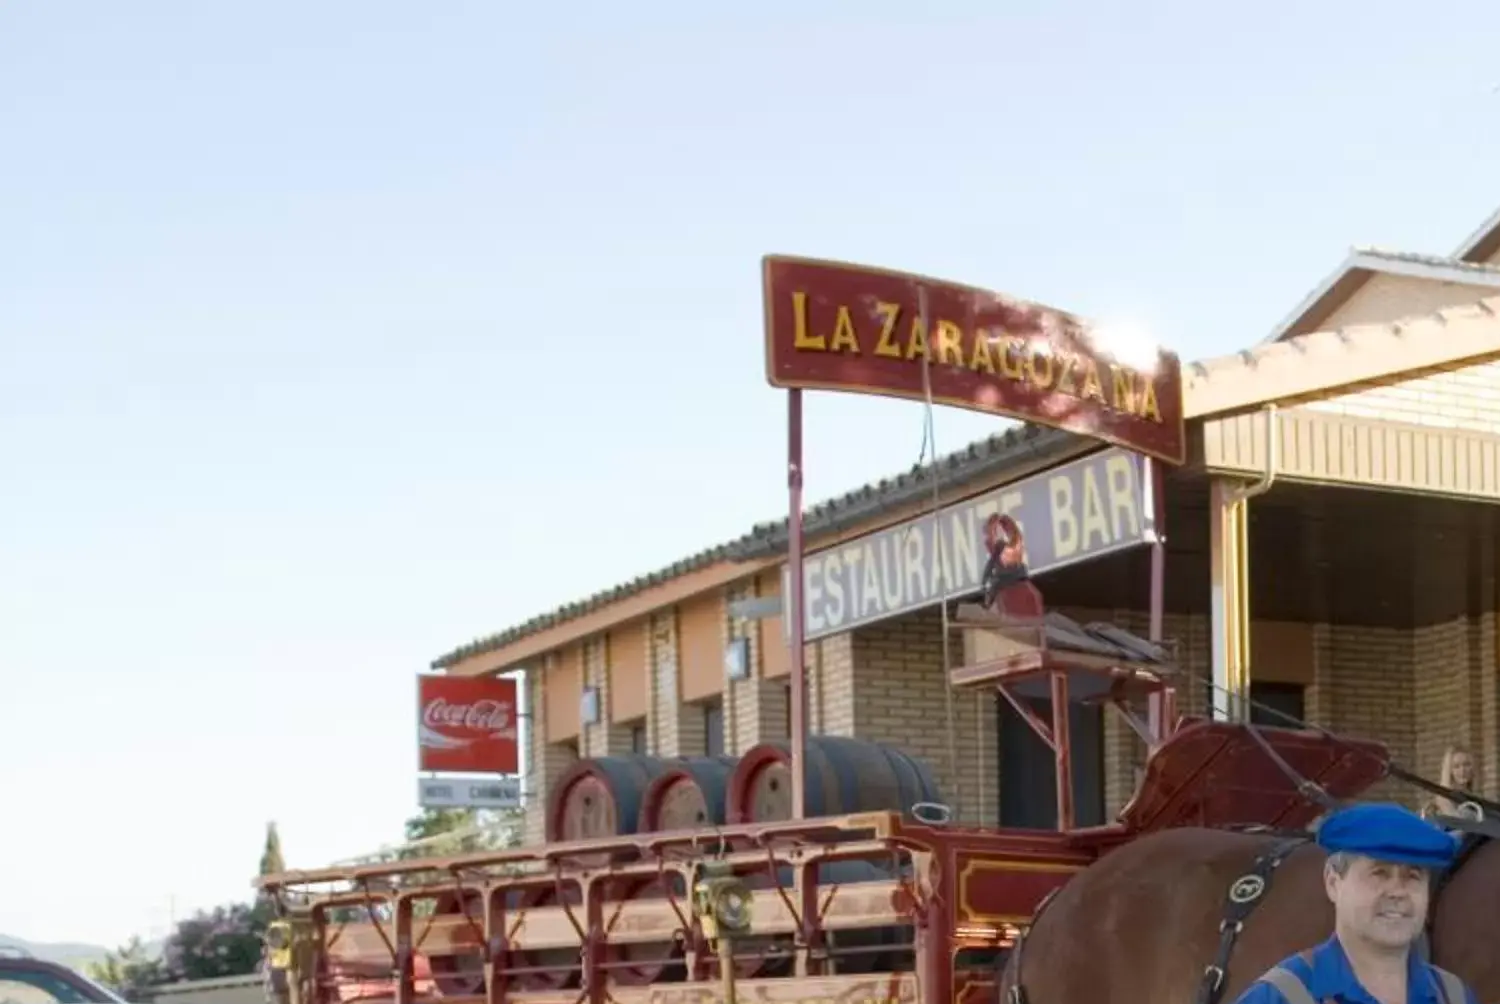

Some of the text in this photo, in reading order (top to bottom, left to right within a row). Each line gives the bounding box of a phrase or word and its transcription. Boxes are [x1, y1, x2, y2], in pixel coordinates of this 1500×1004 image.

[791, 291, 1164, 423] LA ZARAGOZANA
[1049, 455, 1138, 558] BAR
